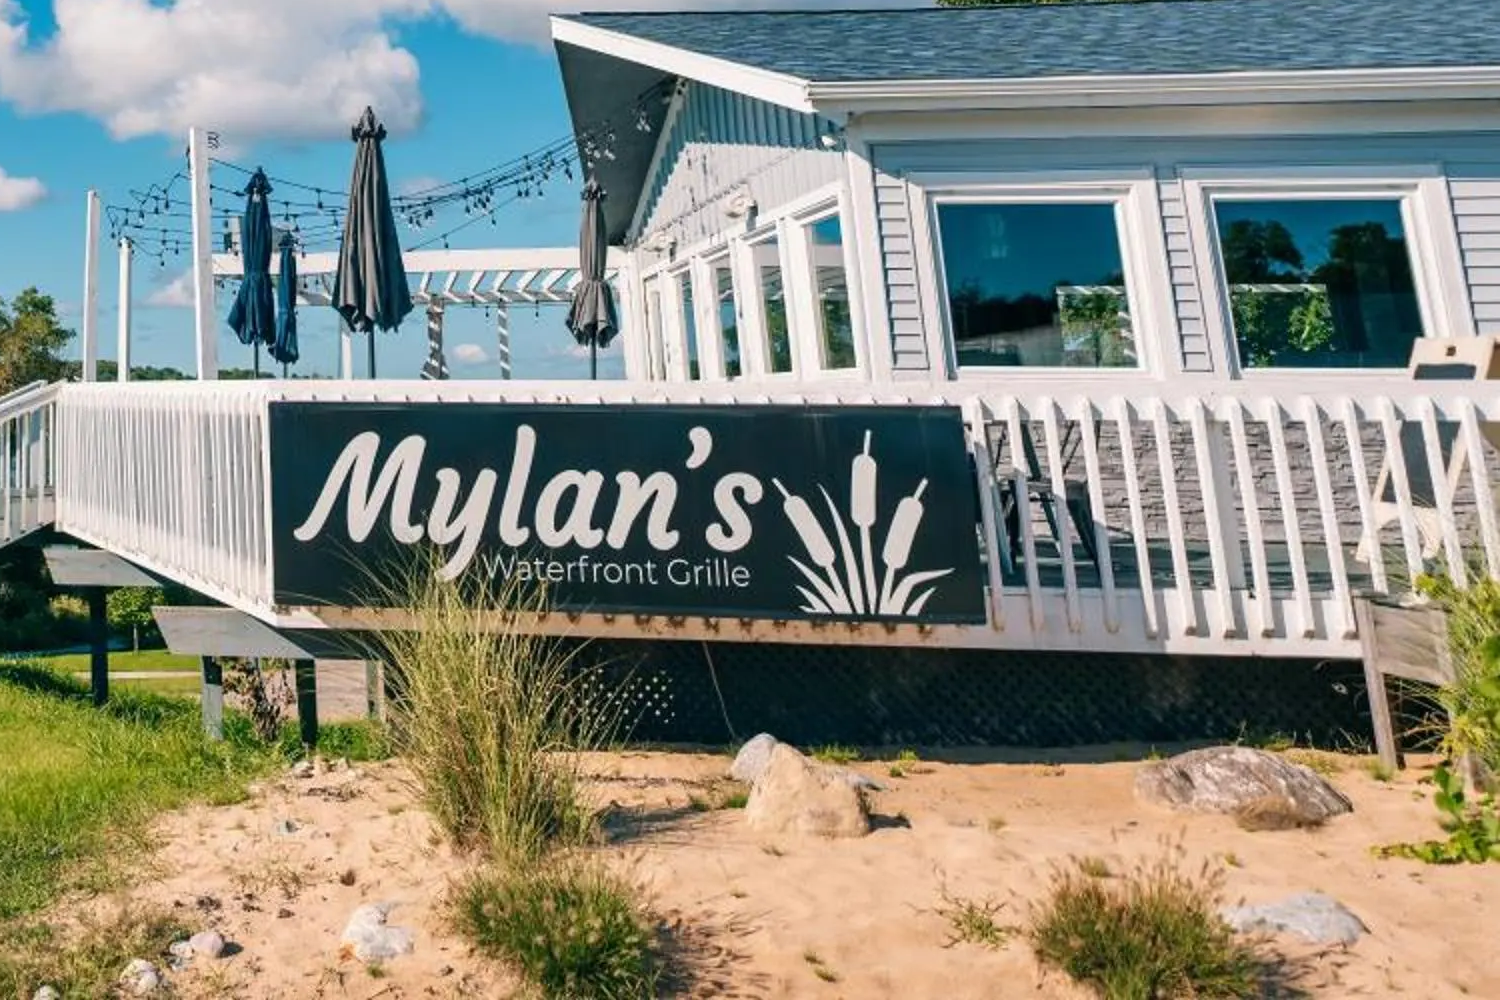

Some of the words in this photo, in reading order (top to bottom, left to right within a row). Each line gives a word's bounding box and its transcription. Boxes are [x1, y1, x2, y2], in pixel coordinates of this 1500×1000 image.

[294, 424, 764, 582] Mylan's
[481, 552, 658, 584] Waterfront
[667, 558, 751, 587] Grille
